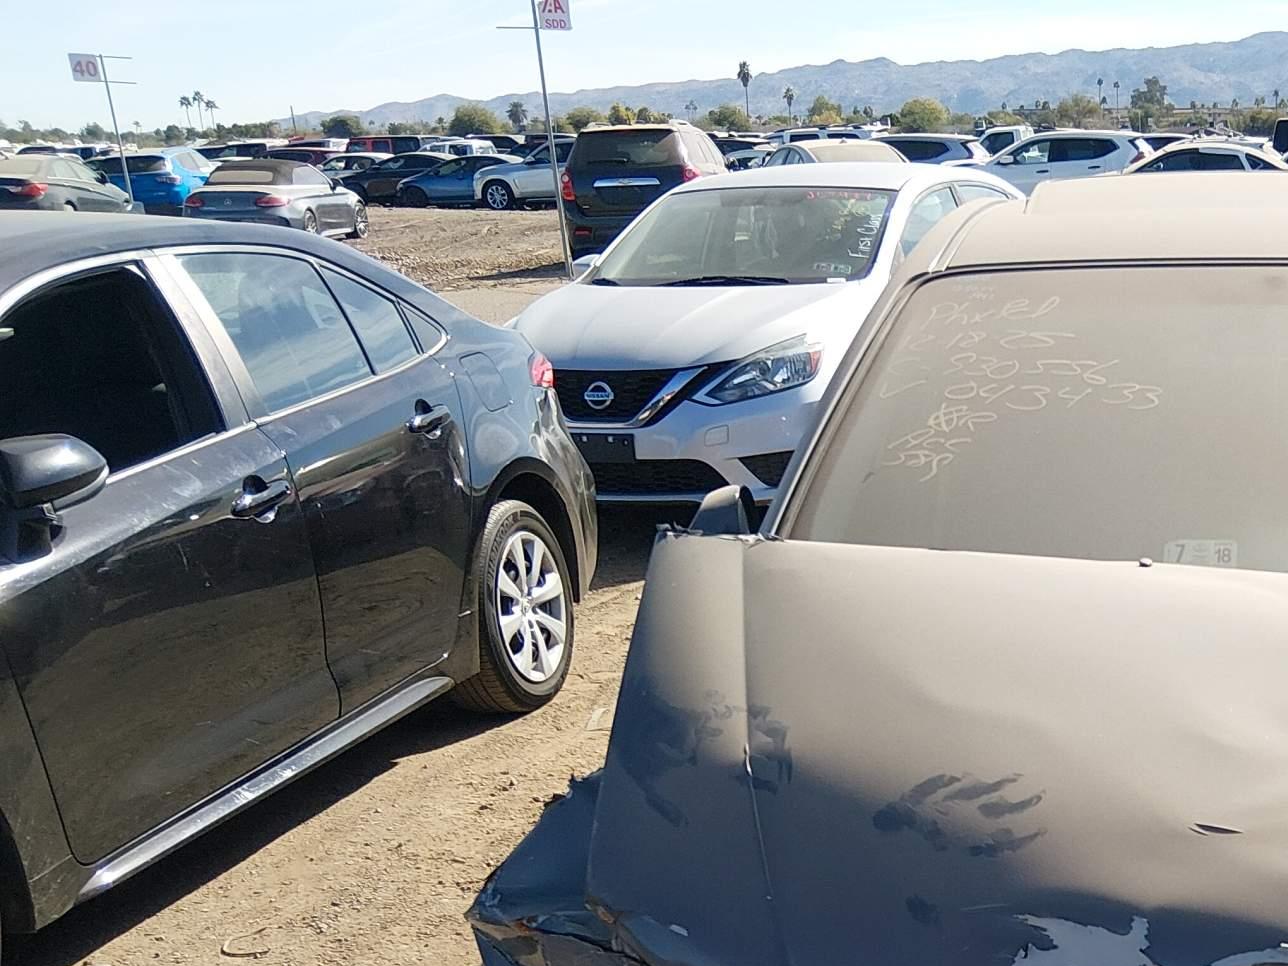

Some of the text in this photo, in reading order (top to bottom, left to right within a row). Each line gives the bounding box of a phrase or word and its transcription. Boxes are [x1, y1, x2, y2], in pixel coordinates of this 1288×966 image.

[545, 18, 567, 29] SDD
[73, 60, 97, 77] 40
[1215, 547, 1232, 563] 18
